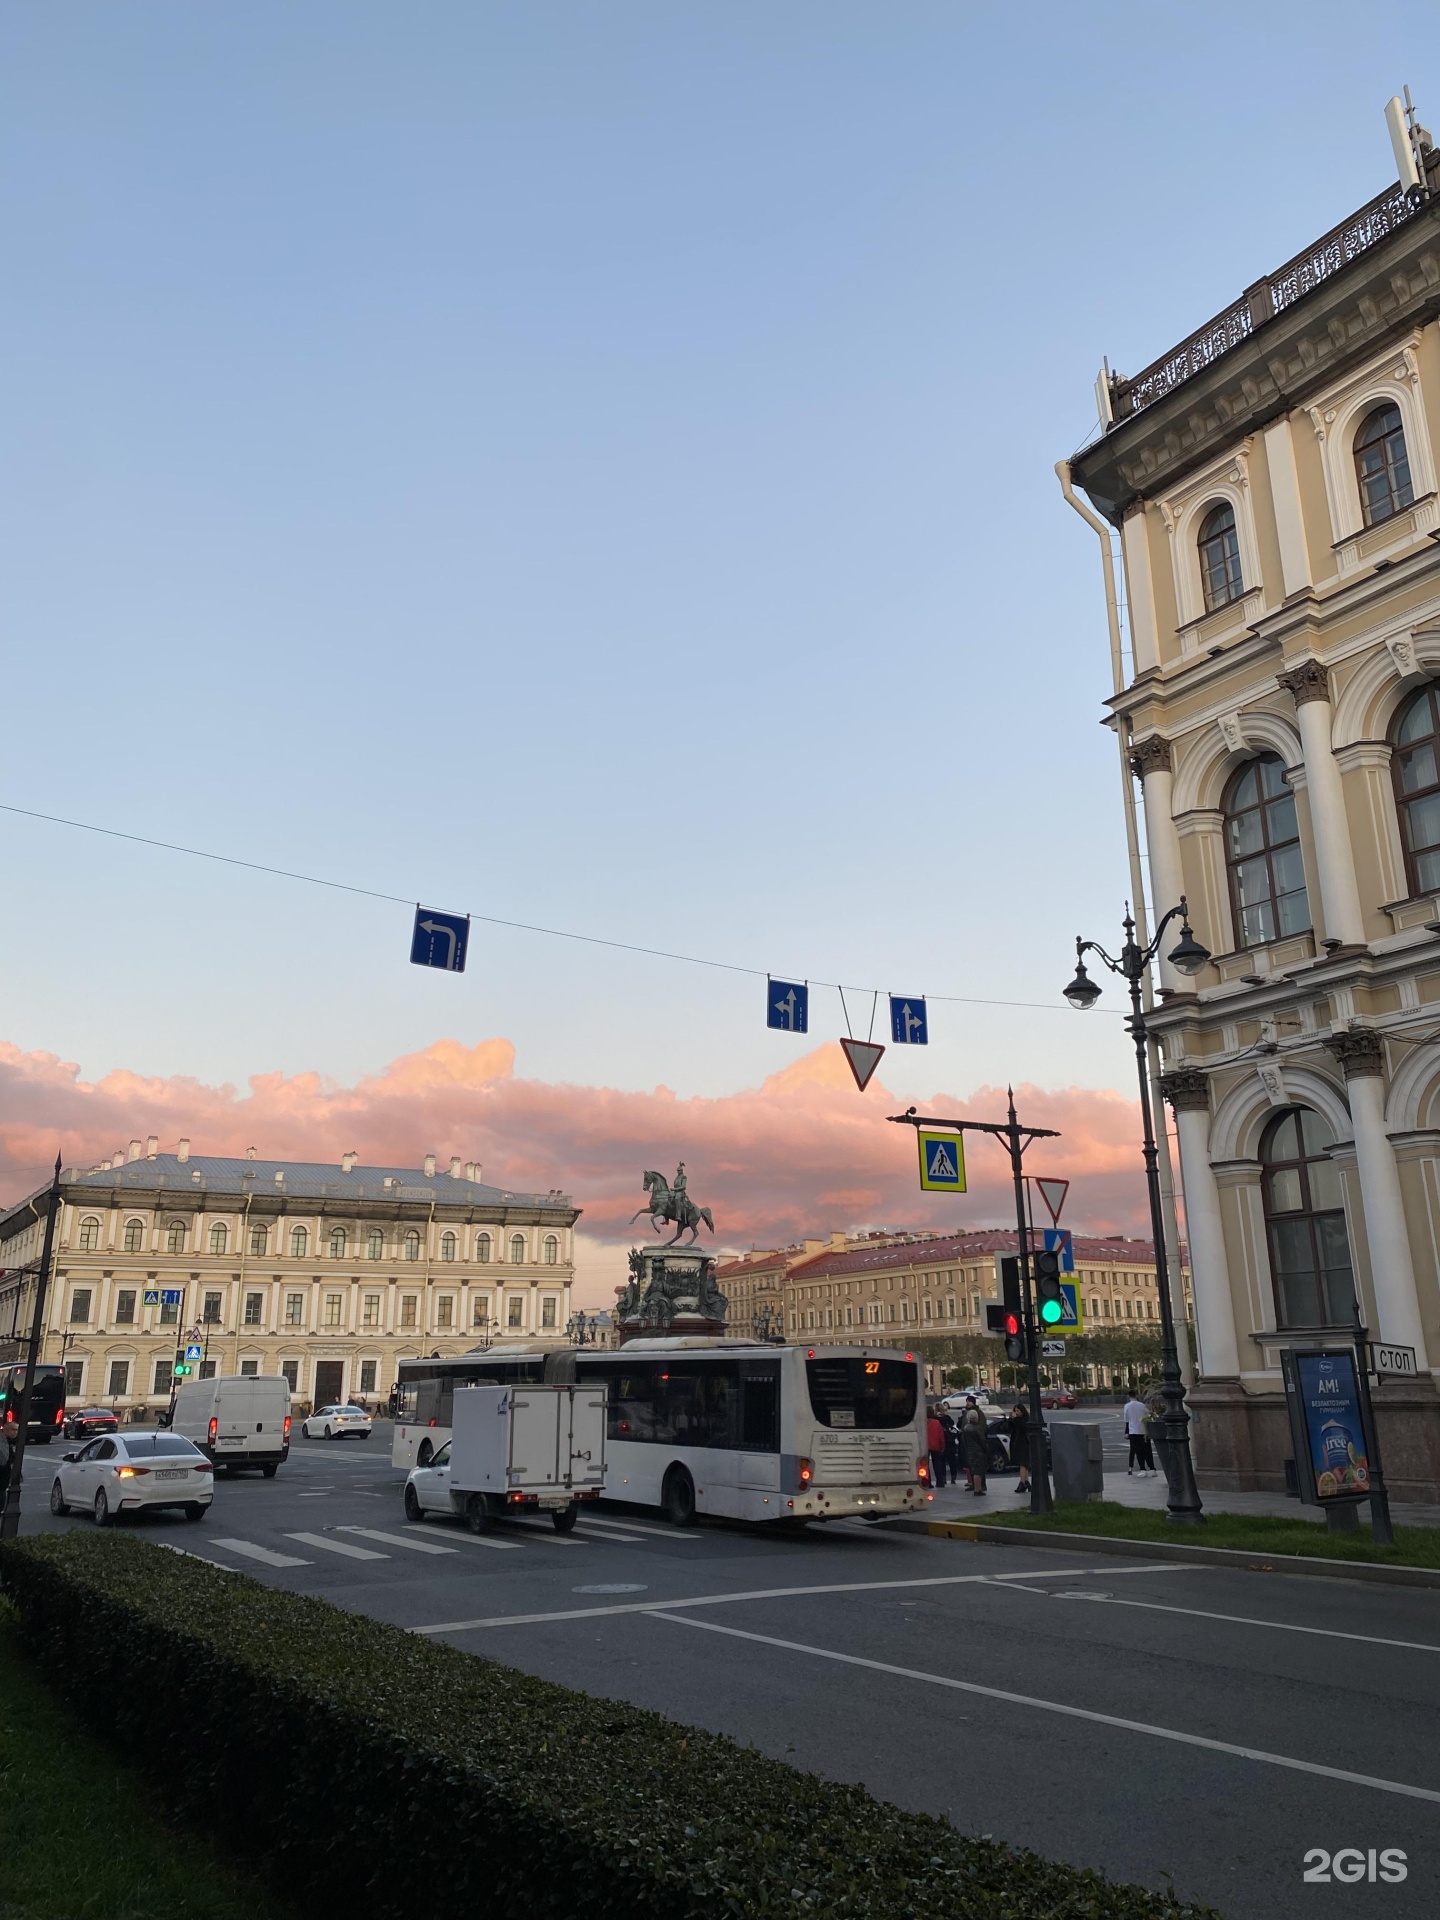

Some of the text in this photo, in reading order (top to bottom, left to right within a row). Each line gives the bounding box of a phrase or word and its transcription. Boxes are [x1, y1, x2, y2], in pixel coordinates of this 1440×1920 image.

[865, 1362, 880, 1373] 27
[1380, 1350, 1411, 1371] СТОП
[1318, 1379, 1340, 1394] АМ!
[1326, 1436, 1347, 1450] free
